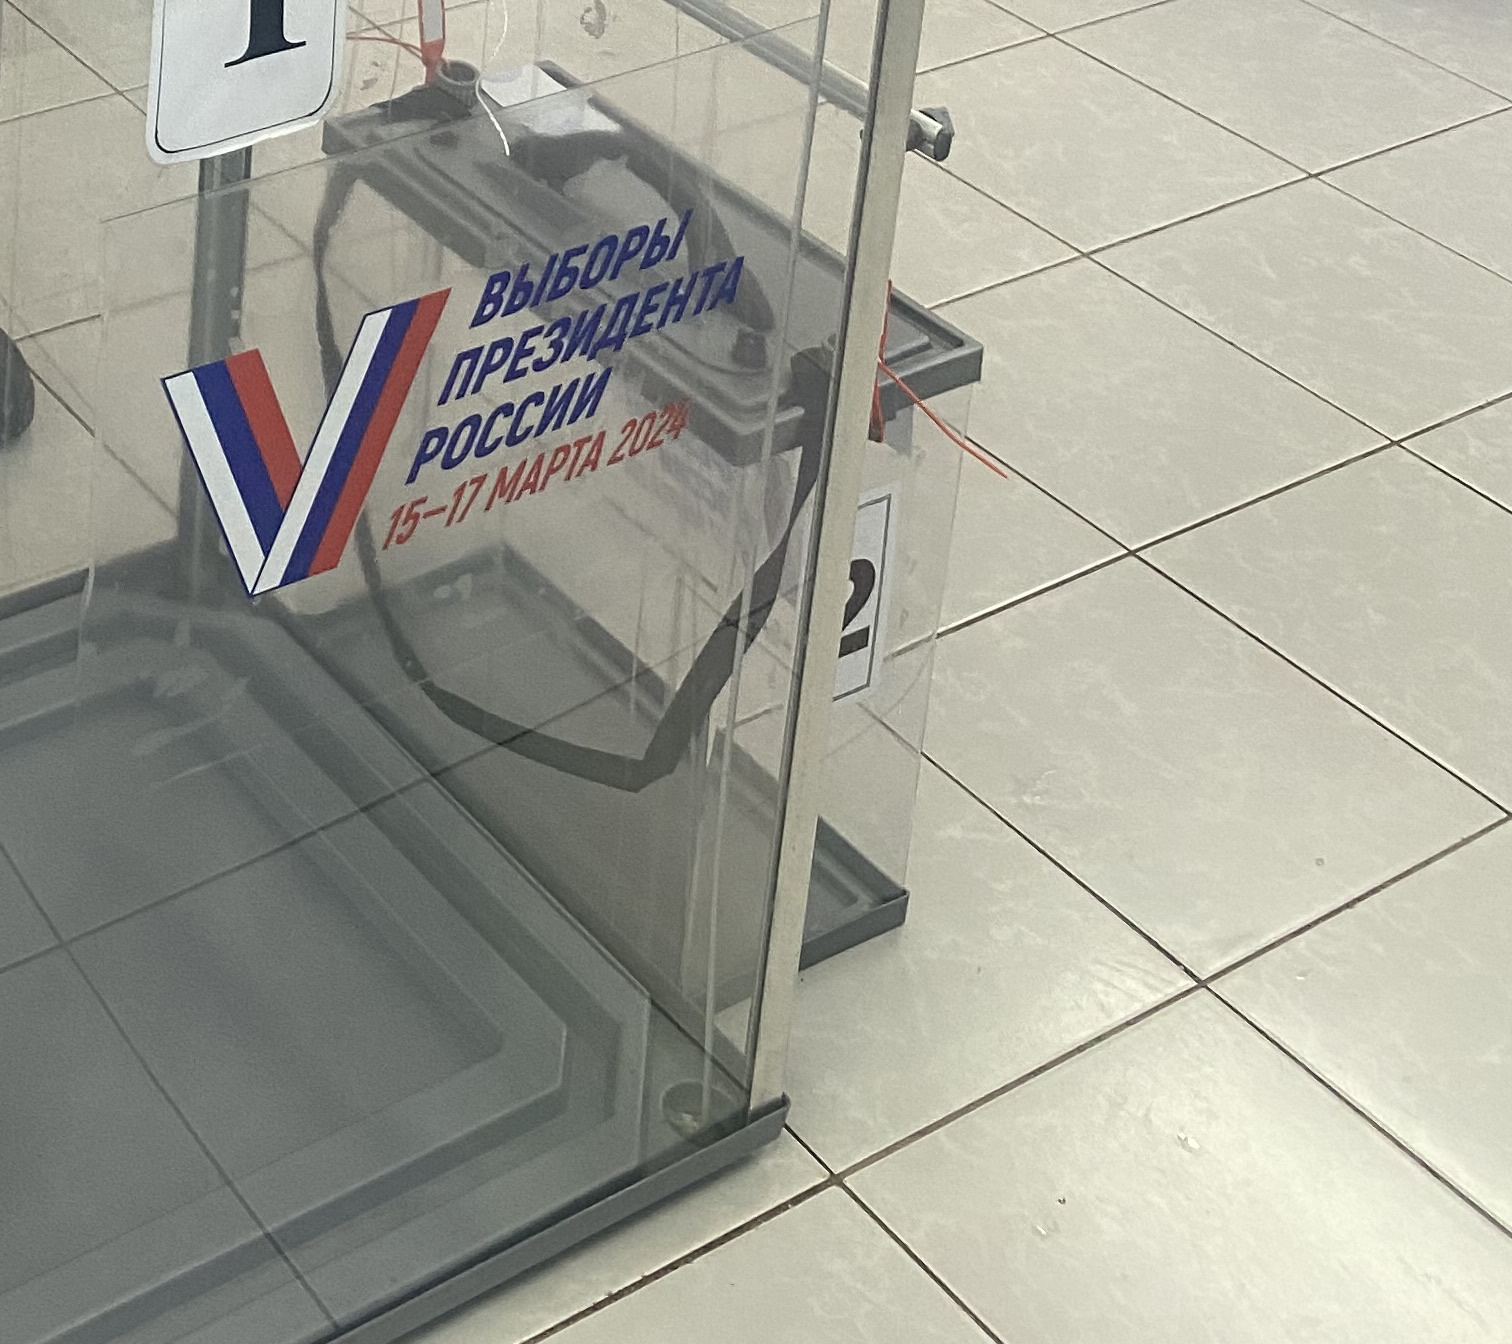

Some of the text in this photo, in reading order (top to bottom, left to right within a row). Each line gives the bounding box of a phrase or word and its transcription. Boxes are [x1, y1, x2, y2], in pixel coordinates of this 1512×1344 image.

[469, 208, 694, 329] ВЫБОРЫ
[437, 255, 745, 407] ПРЕЗИДЕНТА
[405, 367, 613, 486] РОССИИ
[484, 430, 607, 513] МАРТА
[607, 398, 691, 467] 2024
[838, 558, 876, 658] 2
